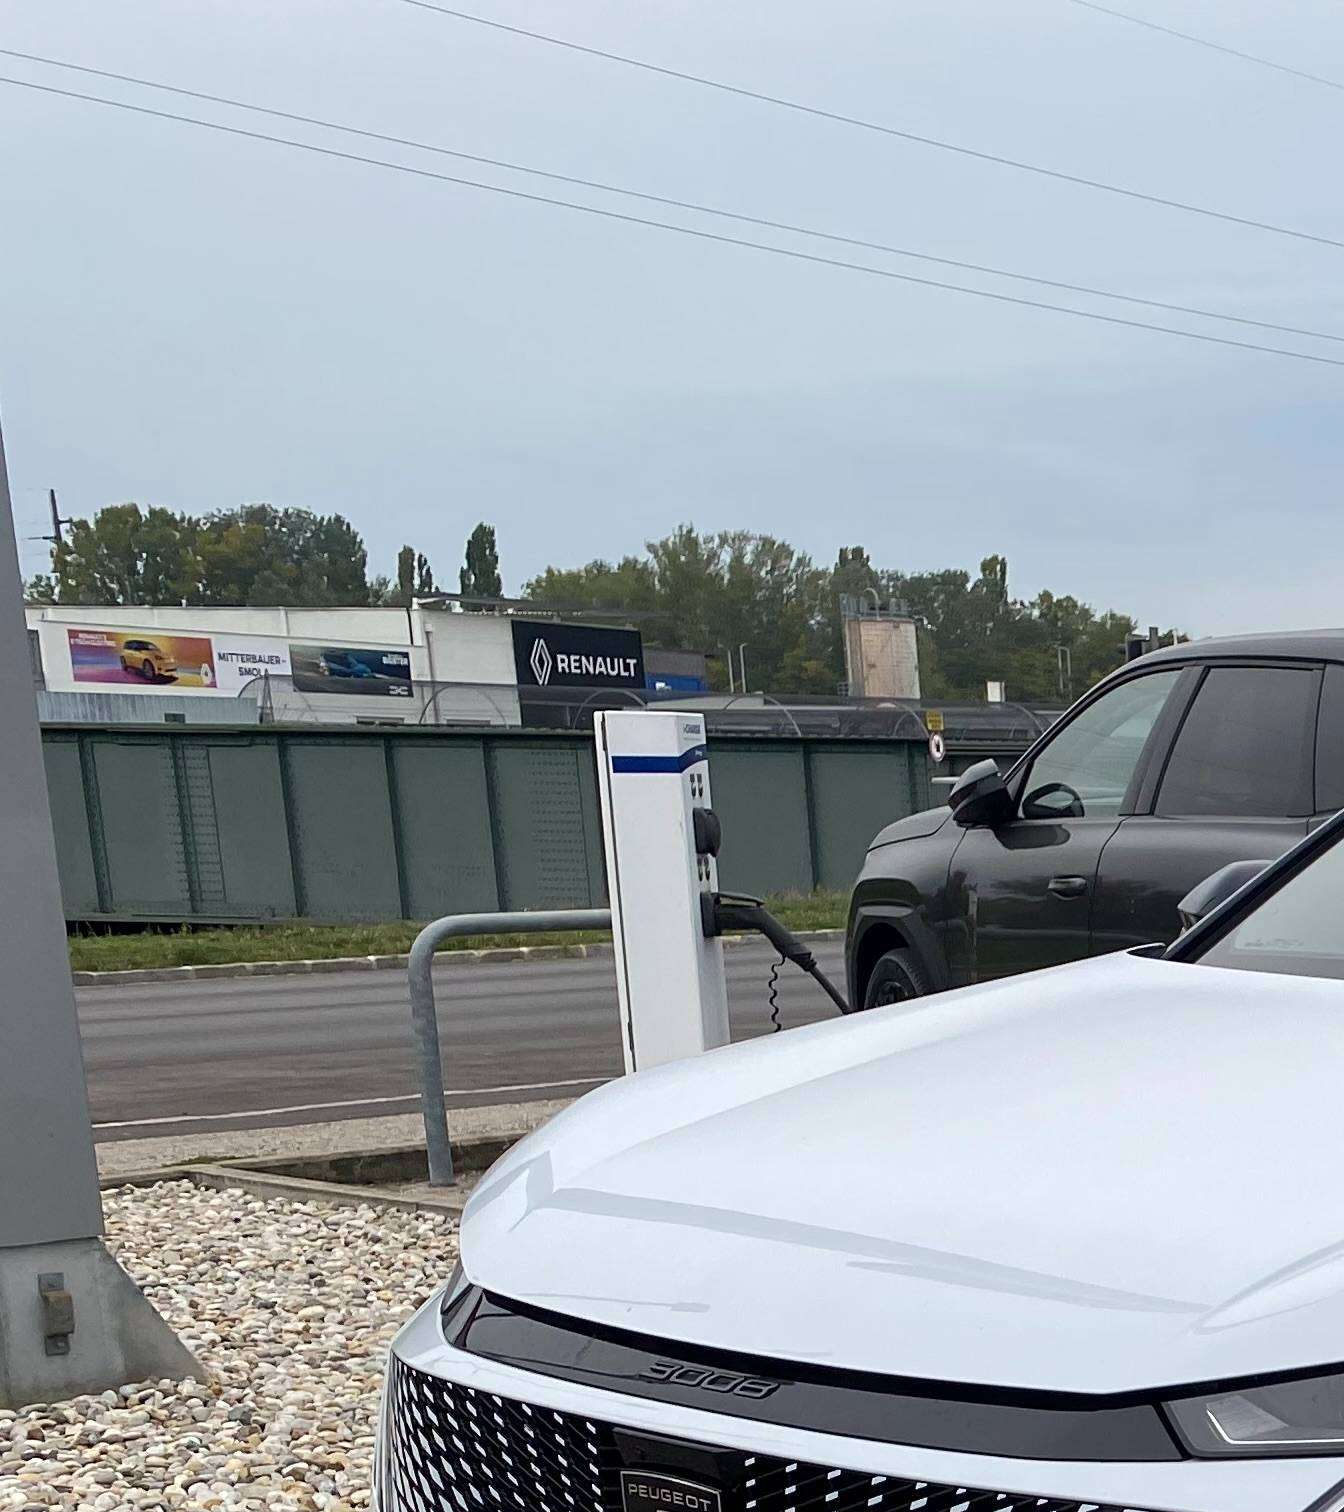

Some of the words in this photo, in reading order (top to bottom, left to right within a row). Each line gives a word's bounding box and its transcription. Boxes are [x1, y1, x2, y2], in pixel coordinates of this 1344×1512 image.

[556, 654, 638, 678] RENAULT
[638, 1360, 781, 1399] 3008
[628, 1483, 712, 1512] PEUGEOT
